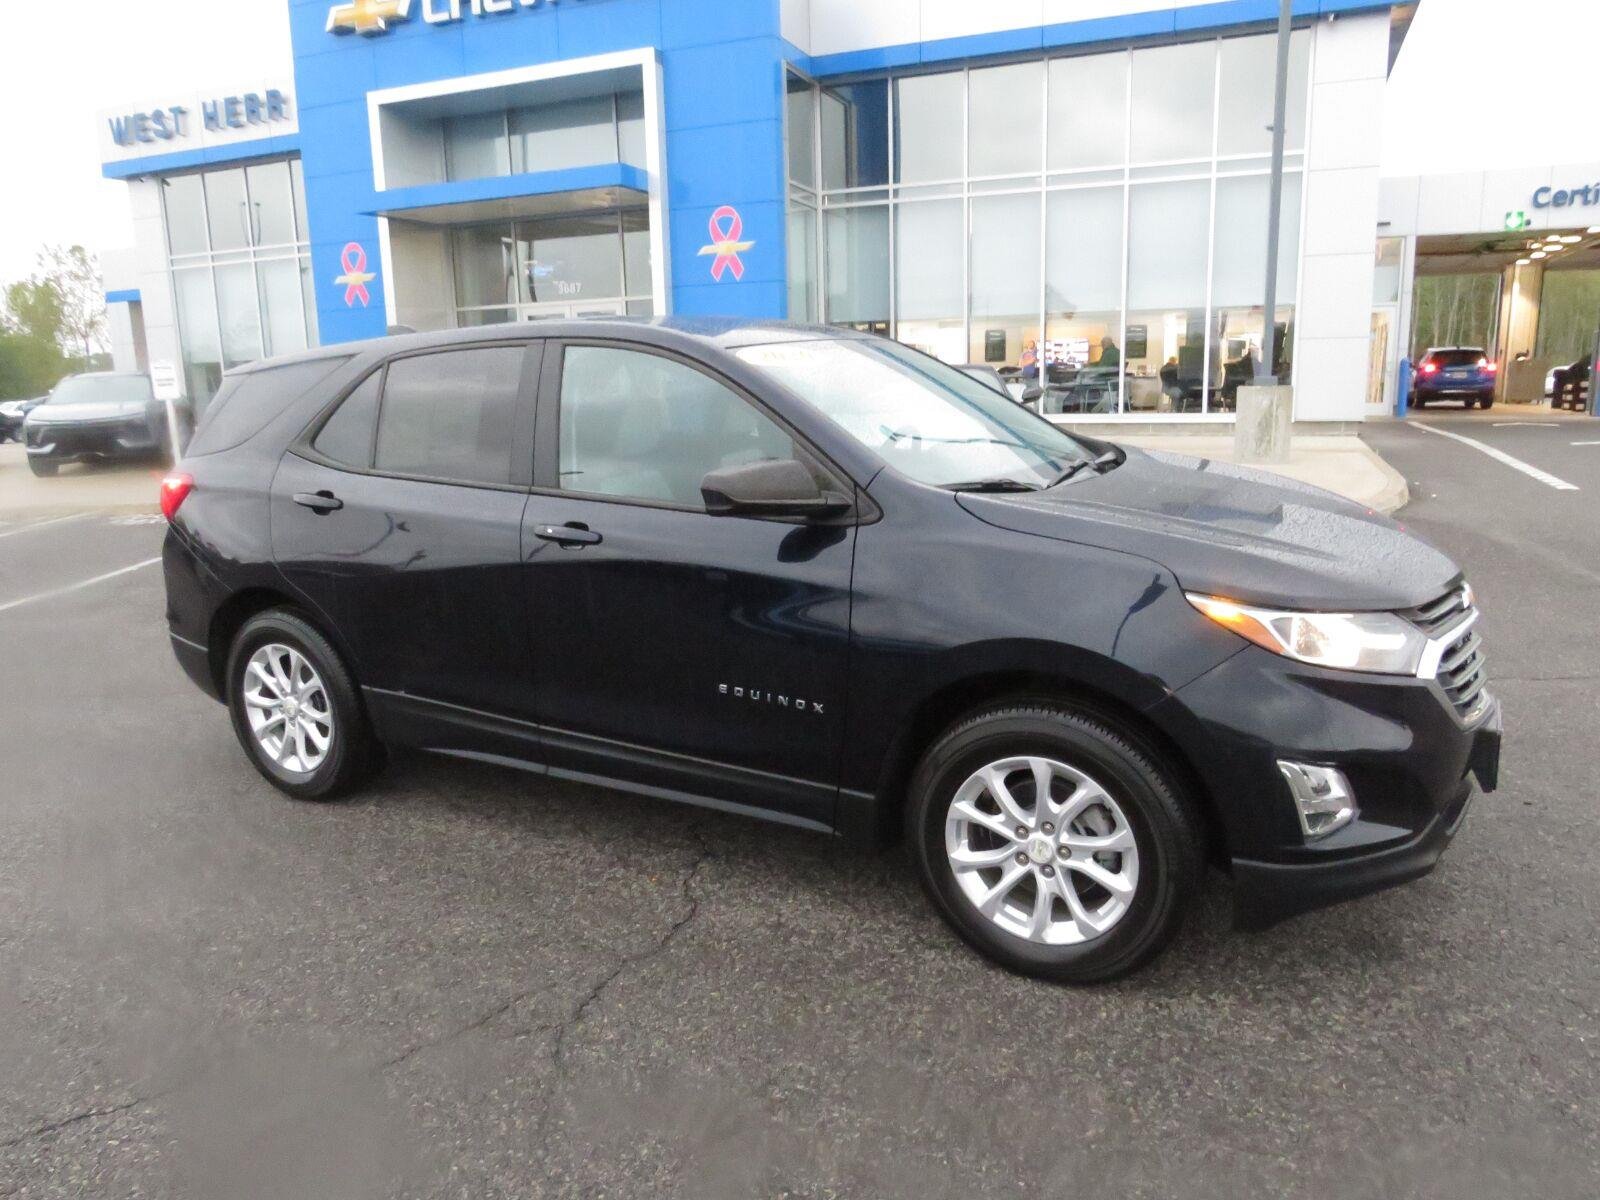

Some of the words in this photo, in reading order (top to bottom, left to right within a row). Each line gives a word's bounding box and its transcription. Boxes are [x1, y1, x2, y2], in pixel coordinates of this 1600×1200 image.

[108, 106, 187, 146] WEST
[202, 89, 290, 131] HERR
[719, 684, 823, 713] EQUINOX
